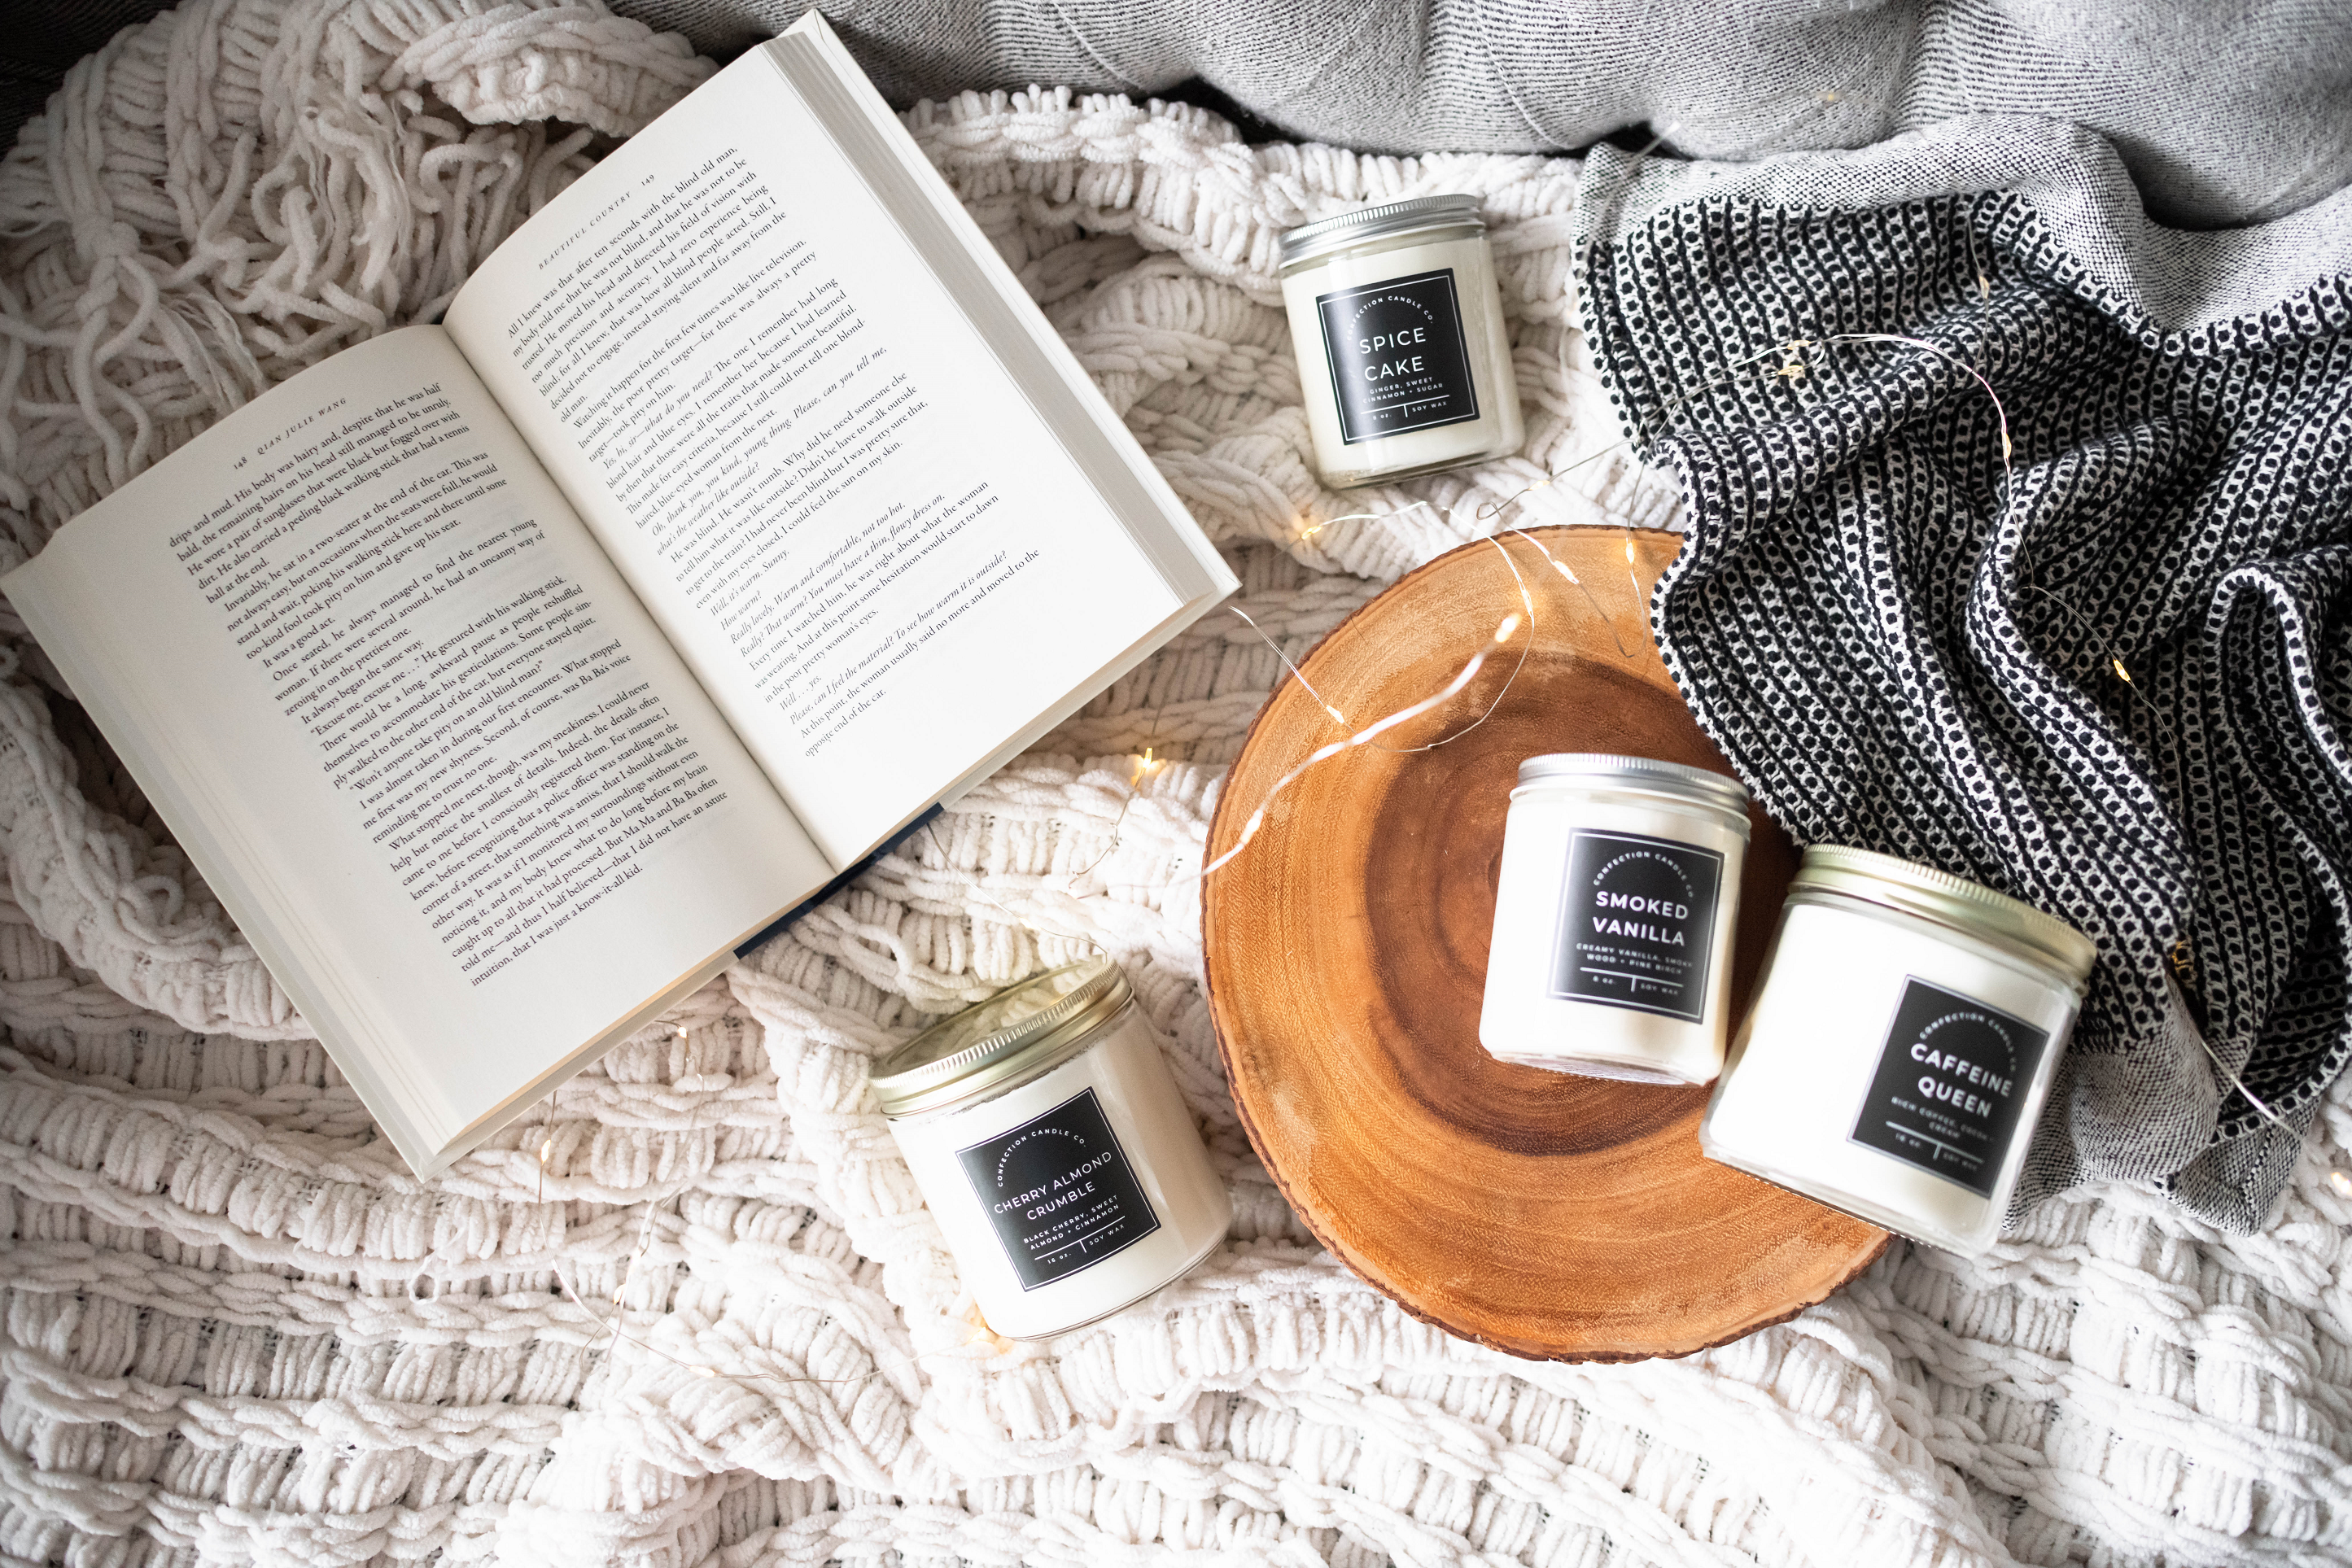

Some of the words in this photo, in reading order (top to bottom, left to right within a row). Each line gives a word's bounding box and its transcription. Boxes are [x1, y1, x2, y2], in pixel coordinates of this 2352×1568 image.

[508, 322, 519, 338] All
[517, 317, 523, 326] I
[521, 301, 541, 321] knew
[542, 287, 557, 301] was
[557, 273, 575, 288] that
[575, 256, 592, 274] after
[593, 245, 608, 258] ten
[609, 219, 640, 247] seconds
[640, 203, 661, 220] with
[661, 192, 675, 204] the
[674, 171, 699, 193] blind
[700, 159, 715, 175] old
[715, 147, 737, 164] man,
[538, 228, 586, 269] BEAUTIFUL
[589, 191, 630, 226] COUNTRY
[640, 174, 654, 186] 149
[1347, 296, 1384, 341] CONFECTION
[1388, 295, 1421, 308] CANDLE
[1423, 310, 1434, 324] CO.
[1359, 327, 1426, 354] SPICE
[1364, 356, 1425, 381] CAKE
[1369, 383, 1403, 395] GINGER,
[1406, 377, 1432, 387] SWEET
[1362, 391, 1405, 404] CINNAMON
[1417, 383, 1442, 392] SUGAR
[233, 456, 247, 470] 148
[256, 435, 281, 455] QIAN
[285, 415, 314, 438] JULIE
[317, 397, 346, 416] WANG
[652, 522, 666, 535] Oh,
[667, 500, 687, 523] thank
[688, 490, 704, 504] you,
[705, 474, 719, 490] you
[719, 455, 741, 476] kind,
[743, 436, 768, 459] young
[768, 418, 791, 438] thing.
[793, 397, 820, 418] Please,
[823, 383, 837, 396] can
[839, 370, 854, 387] you
[856, 355, 869, 371] tell
[871, 347, 886, 360] me,
[710, 596, 728, 616] Well,
[728, 585, 740, 601] it's
[739, 571, 763, 592] warm.
[762, 549, 789, 572] Sunny.
[740, 631, 764, 657] Really?
[763, 618, 781, 635] That
[783, 595, 807, 621] warm?
[807, 585, 824, 599] You
[824, 568, 843, 587] must
[842, 554, 862, 572] have
[864, 549, 869, 557] a
[870, 536, 890, 553] thin,
[887, 518, 911, 541] flowy
[912, 503, 931, 520] dress
[932, 494, 945, 505] on.
[272, 662, 298, 680] Once
[300, 638, 331, 663] seated,
[330, 630, 345, 640] he
[348, 609, 377, 631] always
[379, 578, 420, 609] managed
[422, 573, 433, 582] to
[435, 556, 456, 574] find
[457, 549, 474, 561] the
[476, 531, 508, 551] nearest
[509, 519, 537, 536] young
[319, 732, 347, 751] There
[348, 708, 378, 732] would
[377, 701, 391, 712] be
[400, 679, 427, 697] long,
[429, 648, 469, 679] awkward
[470, 633, 496, 655] pause
[498, 626, 509, 635] as
[511, 607, 541, 630] people
[543, 583, 583, 609] reshuffled
[805, 730, 833, 756] opposite
[833, 715, 848, 732] end
[848, 708, 857, 719] of
[857, 700, 871, 712] the
[871, 689, 885, 701] car.
[389, 855, 412, 872] help
[410, 842, 430, 857] but
[431, 823, 458, 845] notice
[460, 811, 475, 823] the
[477, 786, 512, 812] smallest
[514, 773, 524, 787] of
[526, 757, 557, 779] details.
[556, 732, 592, 758] Indeed,
[592, 724, 609, 736] the
[610, 705, 637, 726] details
[638, 696, 660, 710] often
[1594, 851, 1650, 885] CONFECTION
[1655, 854, 1686, 880] CANDLE
[470, 957, 513, 986] intuition,
[512, 941, 531, 957] that
[528, 935, 537, 944] I
[536, 925, 553, 939] was
[552, 914, 571, 931] just
[575, 873, 625, 912] know-it-all
[622, 863, 643, 880] kid.
[1596, 891, 1688, 919] SMOKED
[1576, 943, 1615, 953] CREAMY
[1618, 949, 1661, 962] VANILLA,
[1593, 917, 1684, 946] VANILLA
[1587, 954, 1616, 963] WOOD
[1629, 959, 1650, 968] PINE
[1655, 964, 1681, 974] BIRCH
[1919, 1012, 1984, 1039] CONFECTION
[1911, 1043, 2011, 1096] CAFFEINE
[1891, 1097, 1917, 1111] RICH
[1918, 1077, 1991, 1117] QUEEN
[998, 1136, 1026, 1187] CONFECTION
[1031, 1129, 1069, 1137] CANDLE
[1073, 1134, 1086, 1147] CO.
[994, 1185, 1047, 1214] CHERRY
[1054, 1152, 1111, 1190] ALMOND
[1027, 1181, 1095, 1220] CRUMBLE
[1024, 1230, 1050, 1243] BLACK
[1052, 1213, 1088, 1231] CHERRY,
[1091, 1195, 1117, 1212] SWEET
[1031, 1233, 1063, 1250] ALMOND
[1075, 1204, 1118, 1230] CINNAMON
[1089, 1235, 1104, 1245] SOY
[1108, 1224, 1124, 1235] WAX
